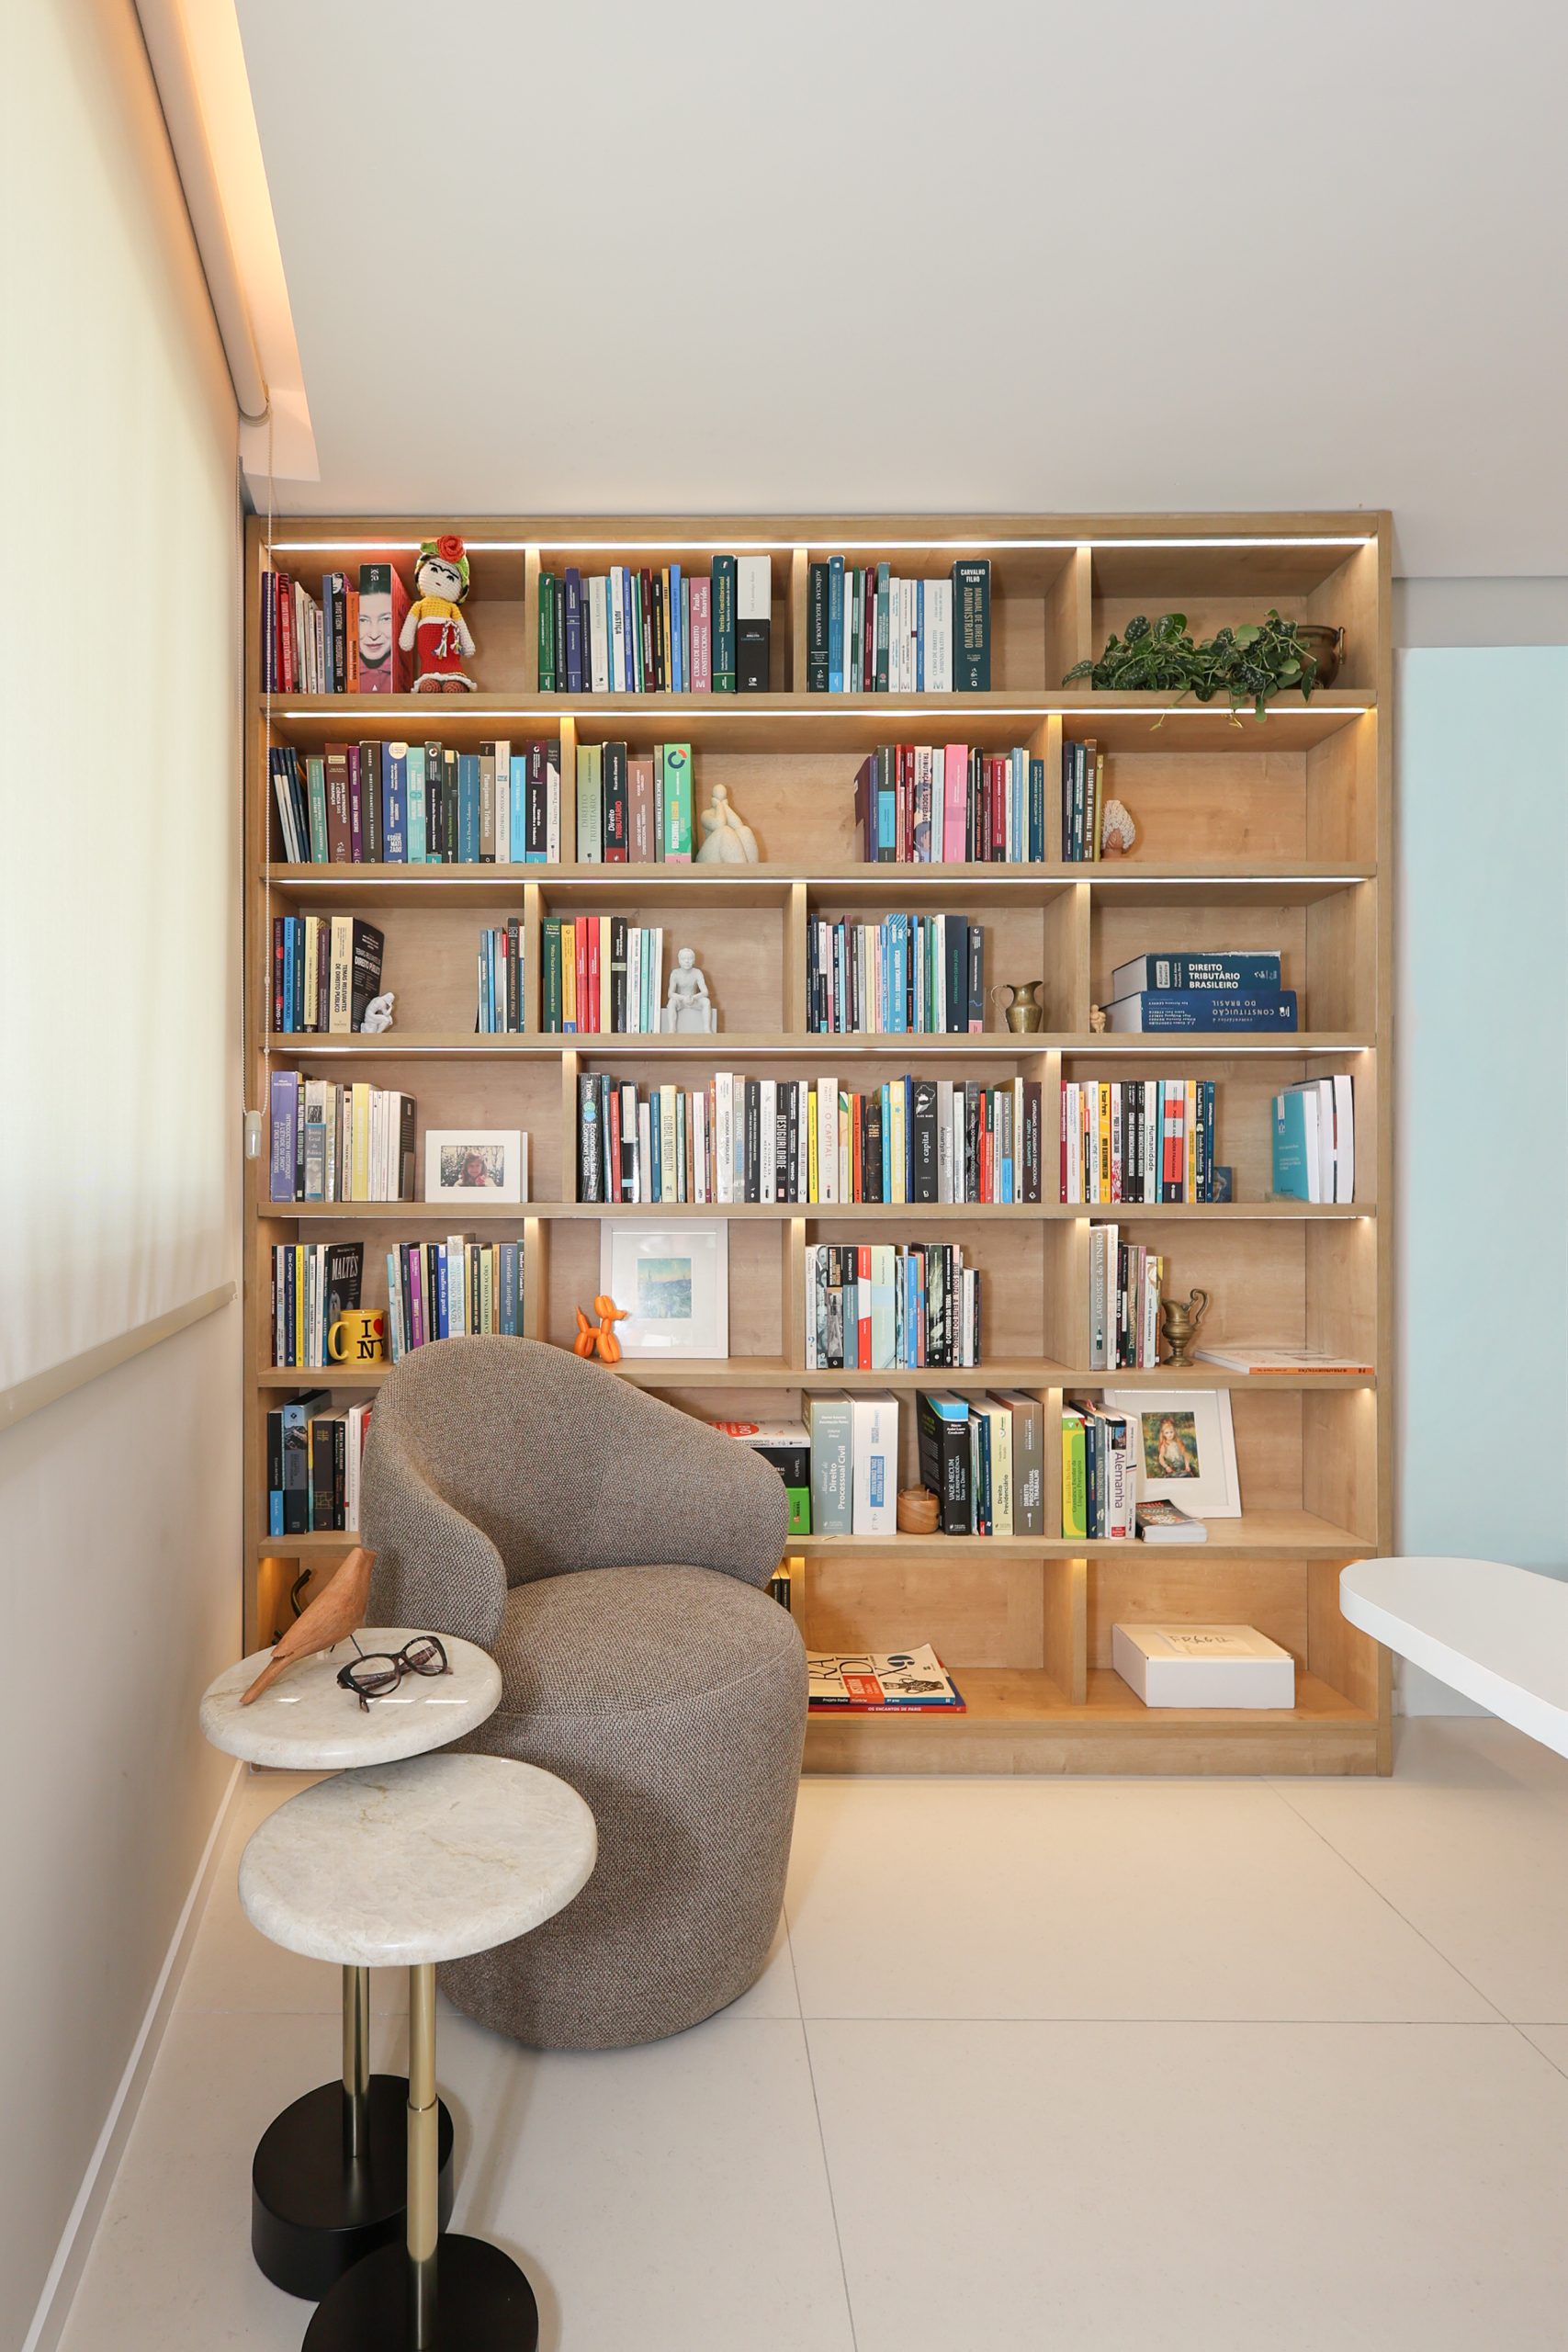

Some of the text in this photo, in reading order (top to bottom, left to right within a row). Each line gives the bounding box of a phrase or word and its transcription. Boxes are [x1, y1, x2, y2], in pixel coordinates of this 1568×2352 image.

[975, 587, 983, 613] MANUAL
[614, 611, 622, 634] JUSTIÇA
[964, 587, 973, 648] ADMINISTRATIVO
[975, 624, 983, 648] DIREITO
[693, 649, 700, 657] DE
[589, 794, 597, 842] TRIBUTÁRIO
[1190, 971, 1240, 980] TRIBUTÁRIO
[585, 1080, 593, 1100] Tirole
[581, 1123, 590, 1176] Common Good
[663, 1115, 673, 1172] GLOBAL INEQUALITY
[776, 1114, 786, 1170] DESIGUALDADE
[922, 1131, 931, 1157] capital
[1096, 1265, 1103, 1275] do
[450, 1300, 458, 1324] PRAZO
[361, 1319, 372, 1339] I
[829, 1463, 837, 1492] Direito
[838, 1445, 846, 1510] Processual Civil
[1114, 1452, 1125, 1509] Alemanha
